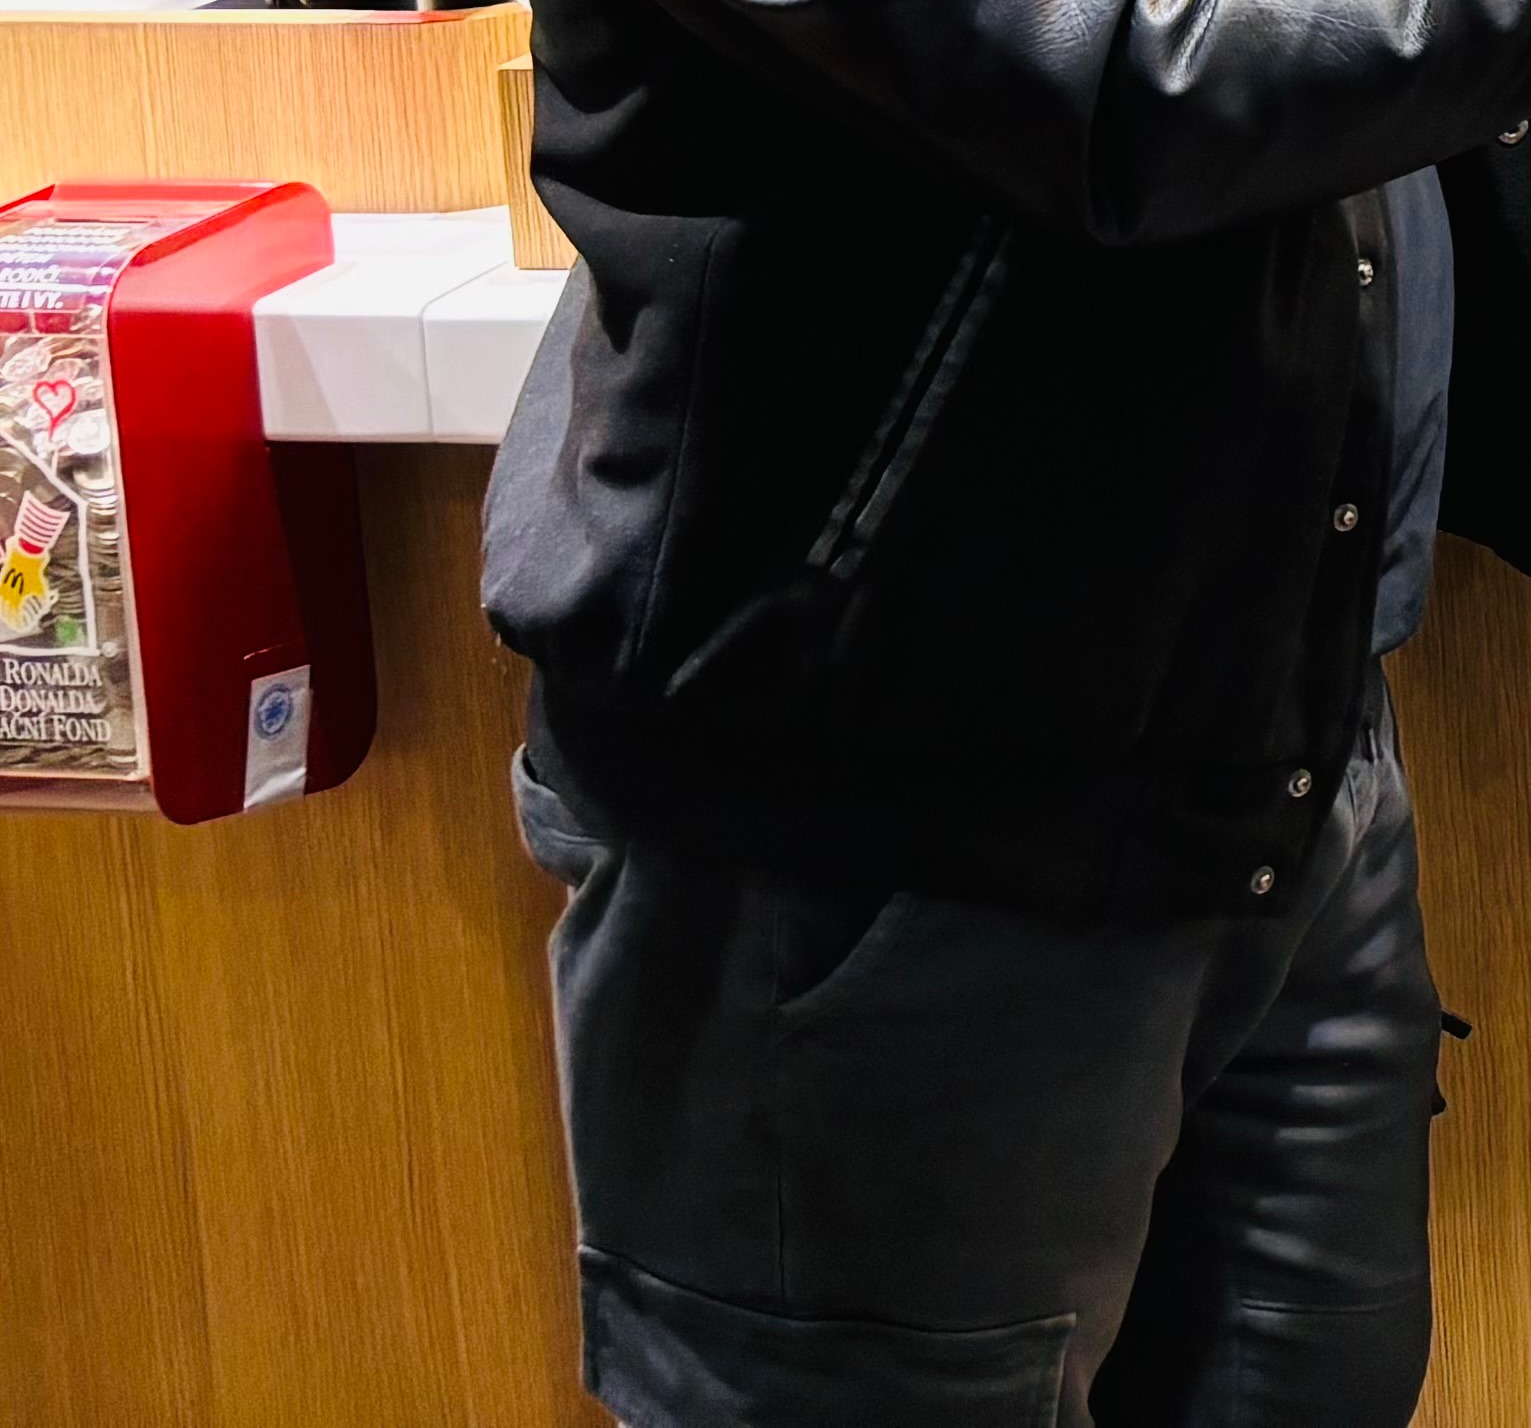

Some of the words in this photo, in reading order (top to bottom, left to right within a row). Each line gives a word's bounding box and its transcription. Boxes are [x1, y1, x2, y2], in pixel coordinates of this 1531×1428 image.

[2, 658, 102, 687] RONALDA
[0, 686, 96, 714] DONALDA
[0, 712, 47, 740] AČNÍ
[51, 715, 112, 742] FOND
